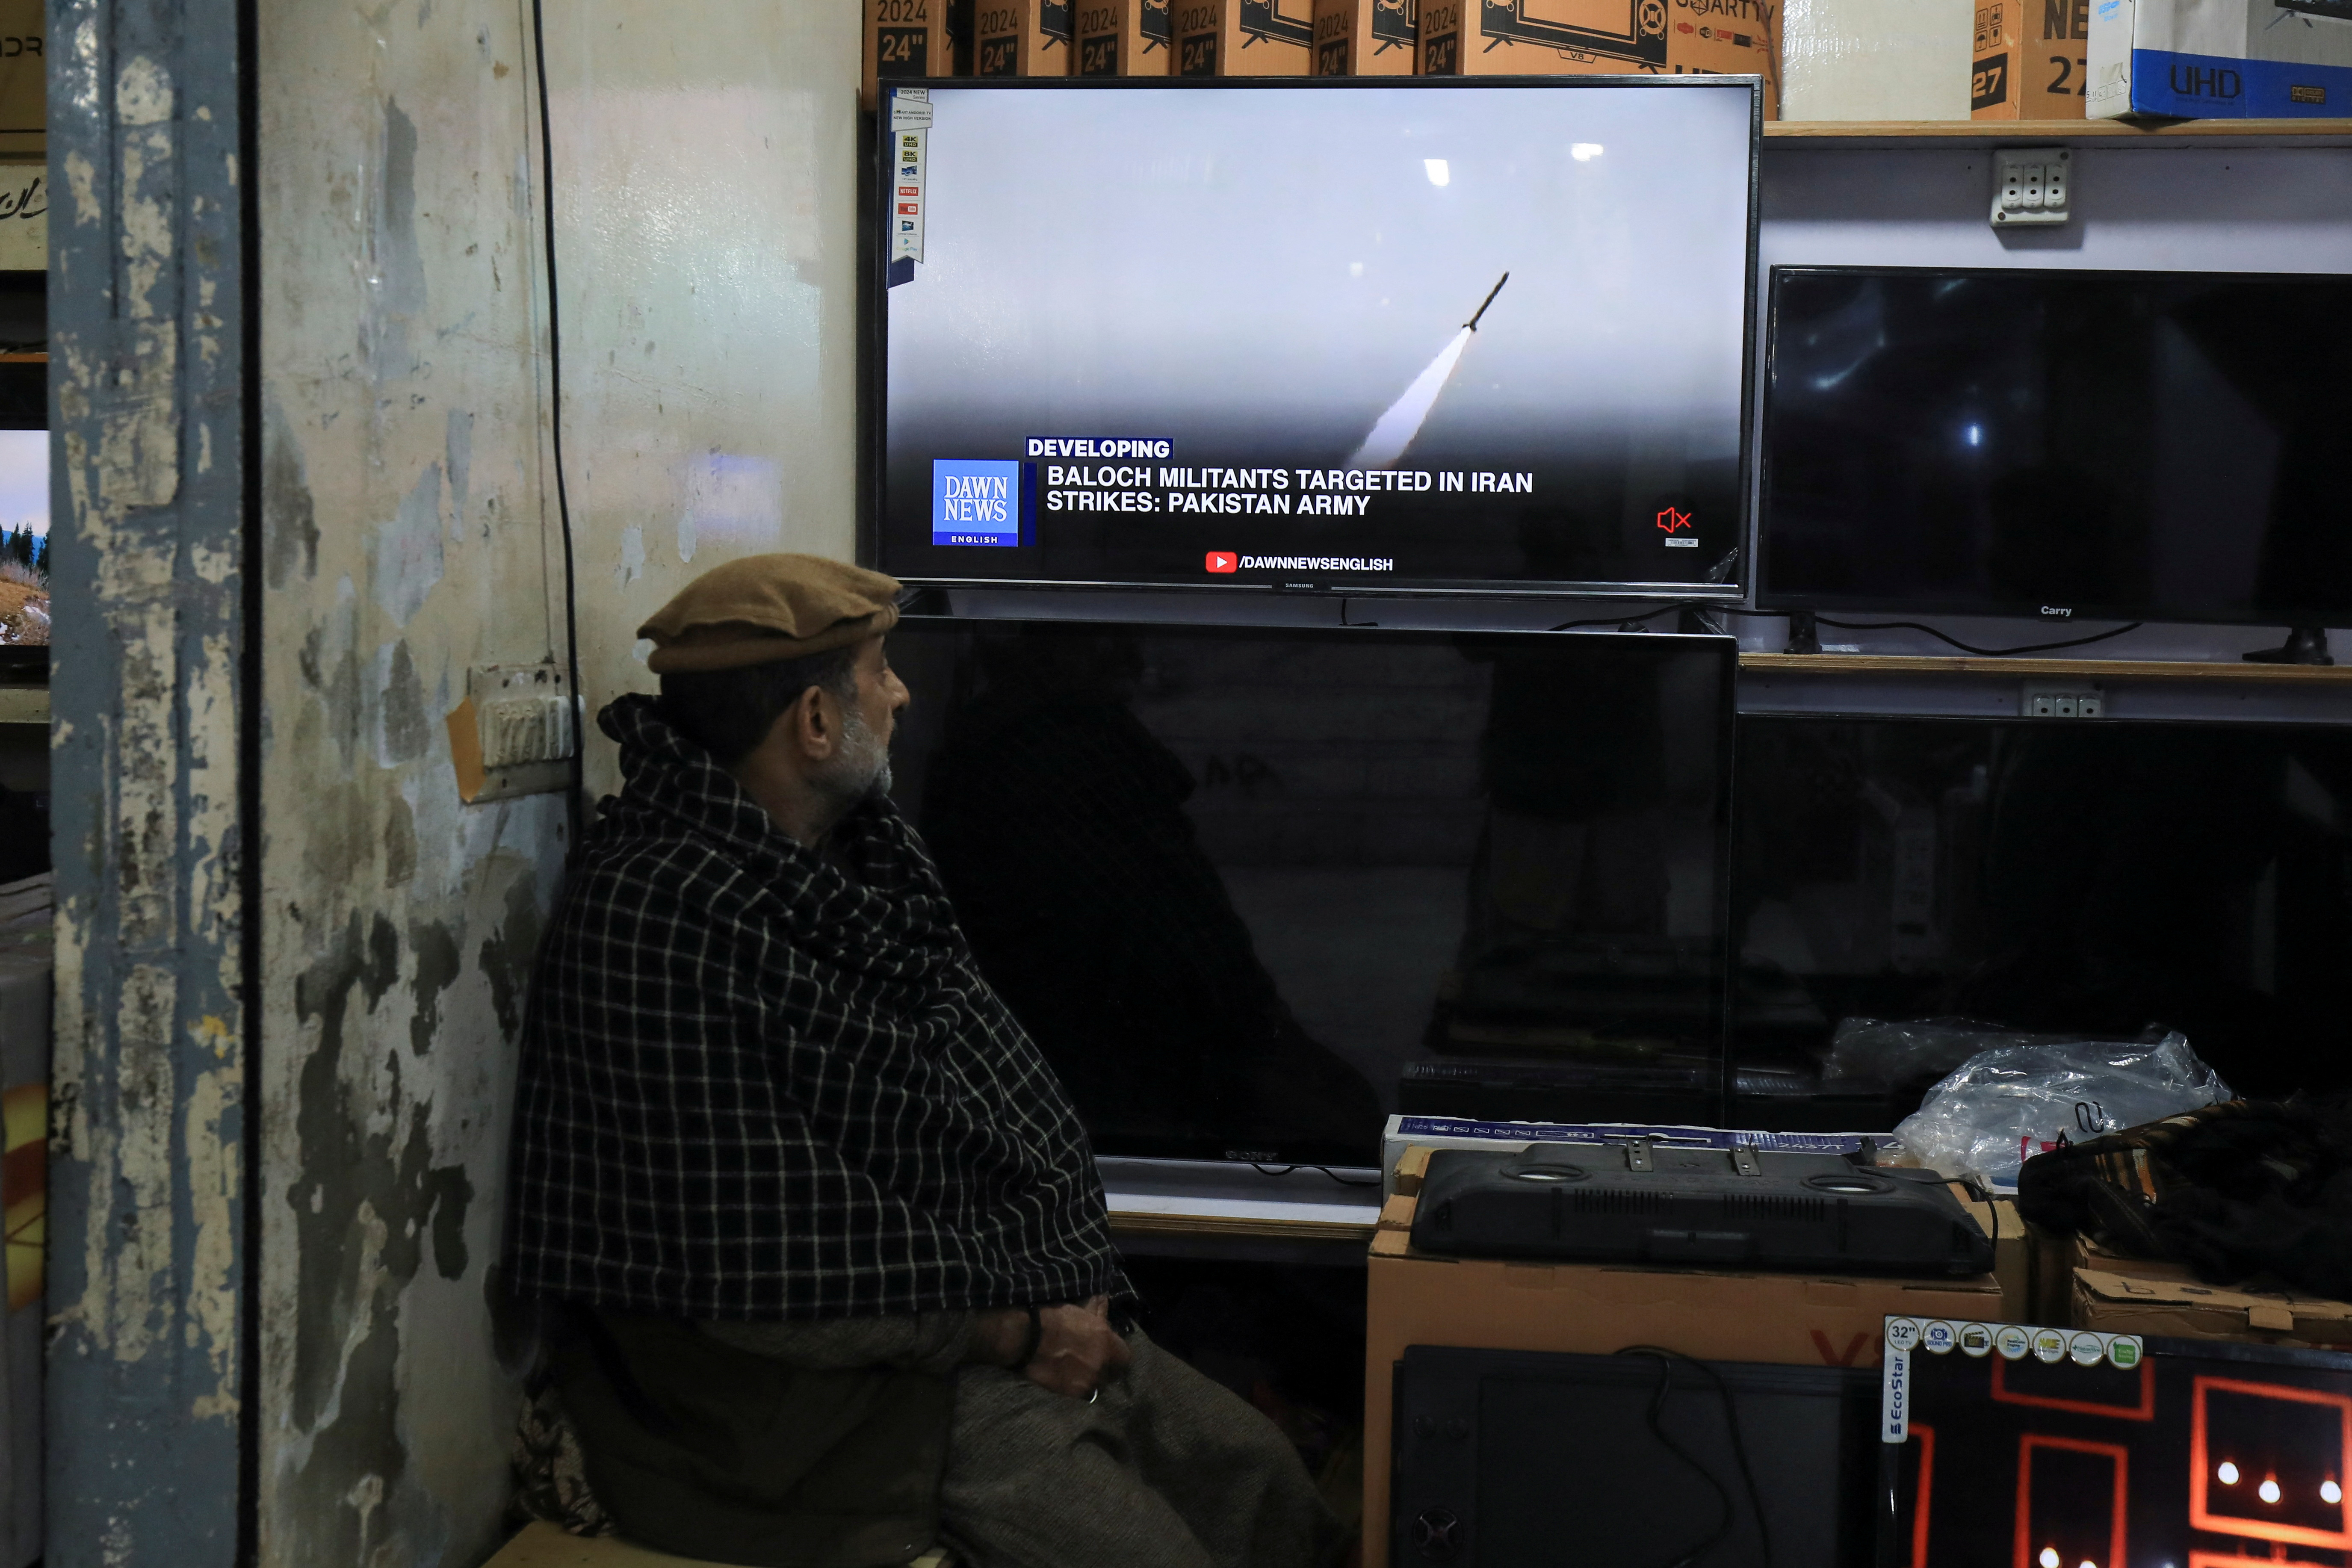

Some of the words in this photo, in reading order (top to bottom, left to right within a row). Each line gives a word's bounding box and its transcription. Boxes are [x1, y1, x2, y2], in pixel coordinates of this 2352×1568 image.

[878, 0, 927, 22] 2024
[981, 8, 1018, 35] 2024
[1081, 6, 1118, 34] 2024
[1182, 5, 1217, 32] 2024
[1425, 4, 1457, 35] 2024
[1319, 11, 1348, 40] 2024
[882, 35, 923, 61] 24"
[984, 43, 1014, 73] 24"
[1085, 41, 1115, 72] 24"
[1184, 40, 1214, 71] 24"
[1322, 46, 1345, 75] 24"
[1429, 39, 1454, 73] 24"
[1570, 51, 1584, 60] V8
[1972, 67, 2002, 98] 27
[2170, 65, 2241, 99] UHD
[1028, 439, 1170, 458] DEVELOPING
[944, 475, 1008, 499] DAWN
[1048, 466, 1152, 487] BALOCH
[1159, 467, 1289, 489] MILITANTS
[1296, 469, 1432, 491] TARGETED
[1439, 472, 1463, 492] IN
[1471, 472, 1533, 493] IRAN
[943, 498, 1008, 522] NEWS
[1046, 490, 1160, 512] STRIKES:
[1168, 492, 1290, 514] PAKISTAN
[1297, 495, 1371, 516] ARMY
[951, 535, 998, 544] ENGLISH
[1239, 555, 1393, 571] /DAWNNEWSENGLISH
[2041, 605, 2072, 617] Carry
[1892, 1326, 1915, 1338] 32"
[1891, 1357, 1903, 1420] EcoStar
